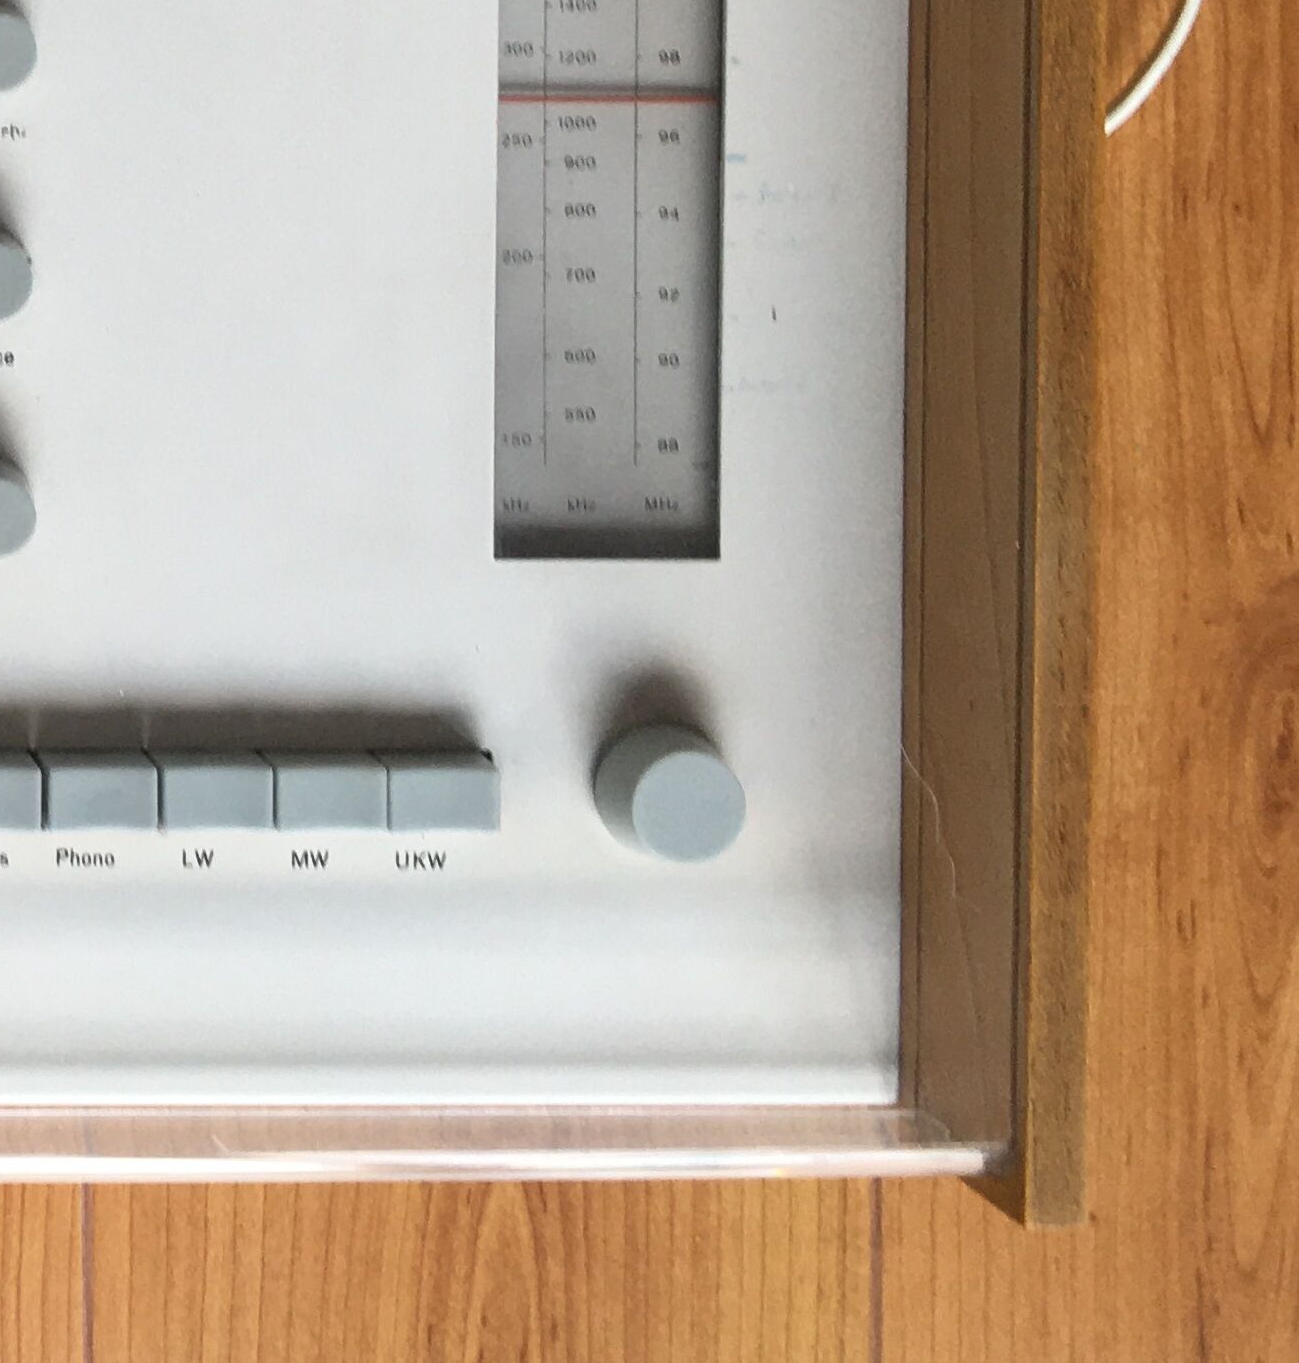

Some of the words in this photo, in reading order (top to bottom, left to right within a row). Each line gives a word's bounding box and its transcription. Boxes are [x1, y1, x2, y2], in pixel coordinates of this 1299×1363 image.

[558, 115, 596, 131] 1000
[55, 848, 116, 868] Phono
[181, 849, 215, 869] LW
[291, 849, 330, 870] MW
[394, 850, 448, 870] UKW
